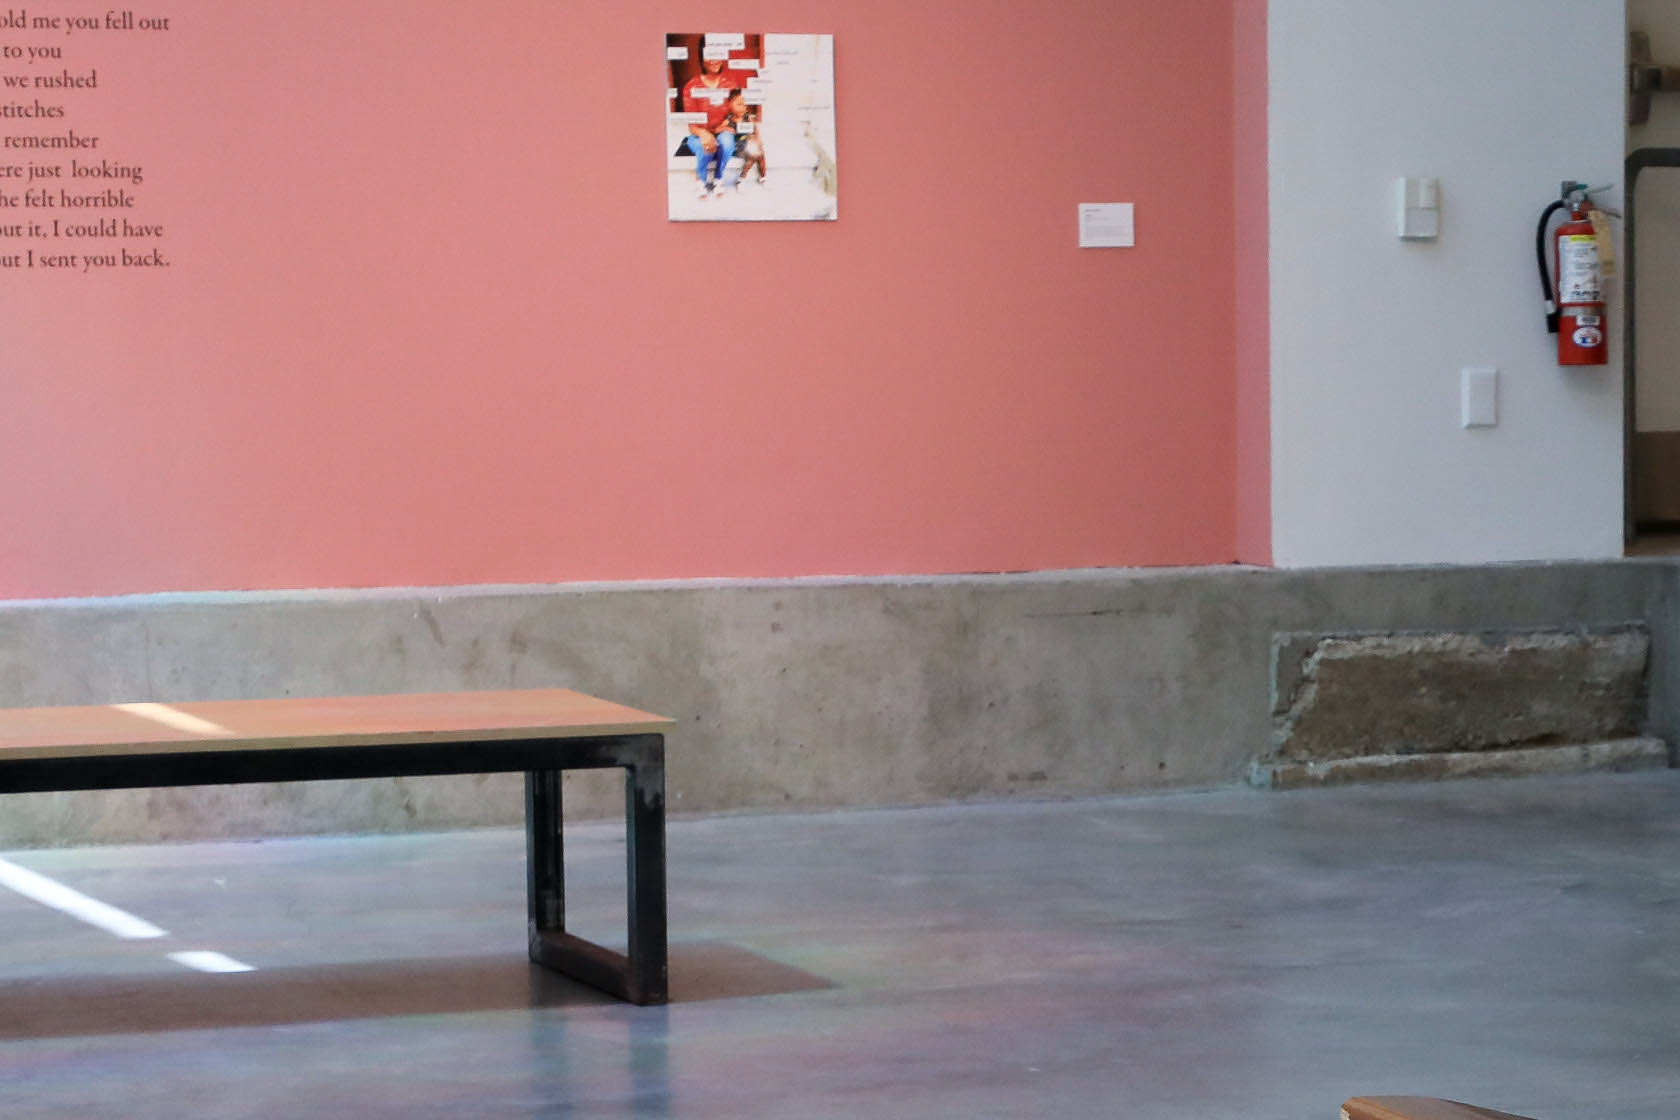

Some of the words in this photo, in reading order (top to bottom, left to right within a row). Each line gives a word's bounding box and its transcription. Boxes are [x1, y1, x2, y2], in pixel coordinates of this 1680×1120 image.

[32, 17, 60, 29] me
[65, 16, 100, 35] you
[105, 11, 134, 30] fell
[138, 16, 170, 31] out
[3, 46, 22, 58] to
[28, 46, 62, 64] you
[4, 75, 29, 88] we
[34, 69, 98, 88] rushed
[4, 130, 99, 148] remember
[28, 161, 62, 182] just
[72, 160, 143, 184] looking
[25, 188, 55, 207] felt
[60, 188, 135, 208] horrible
[0, 225, 22, 237] ut
[28, 221, 48, 238] it,
[53, 219, 60, 237] I
[65, 218, 117, 237] could
[123, 218, 163, 237] have
[0, 255, 21, 268] ut
[27, 250, 34, 267] I
[40, 255, 77, 268] sent
[83, 256, 117, 273] you
[122, 248, 170, 268] back.
